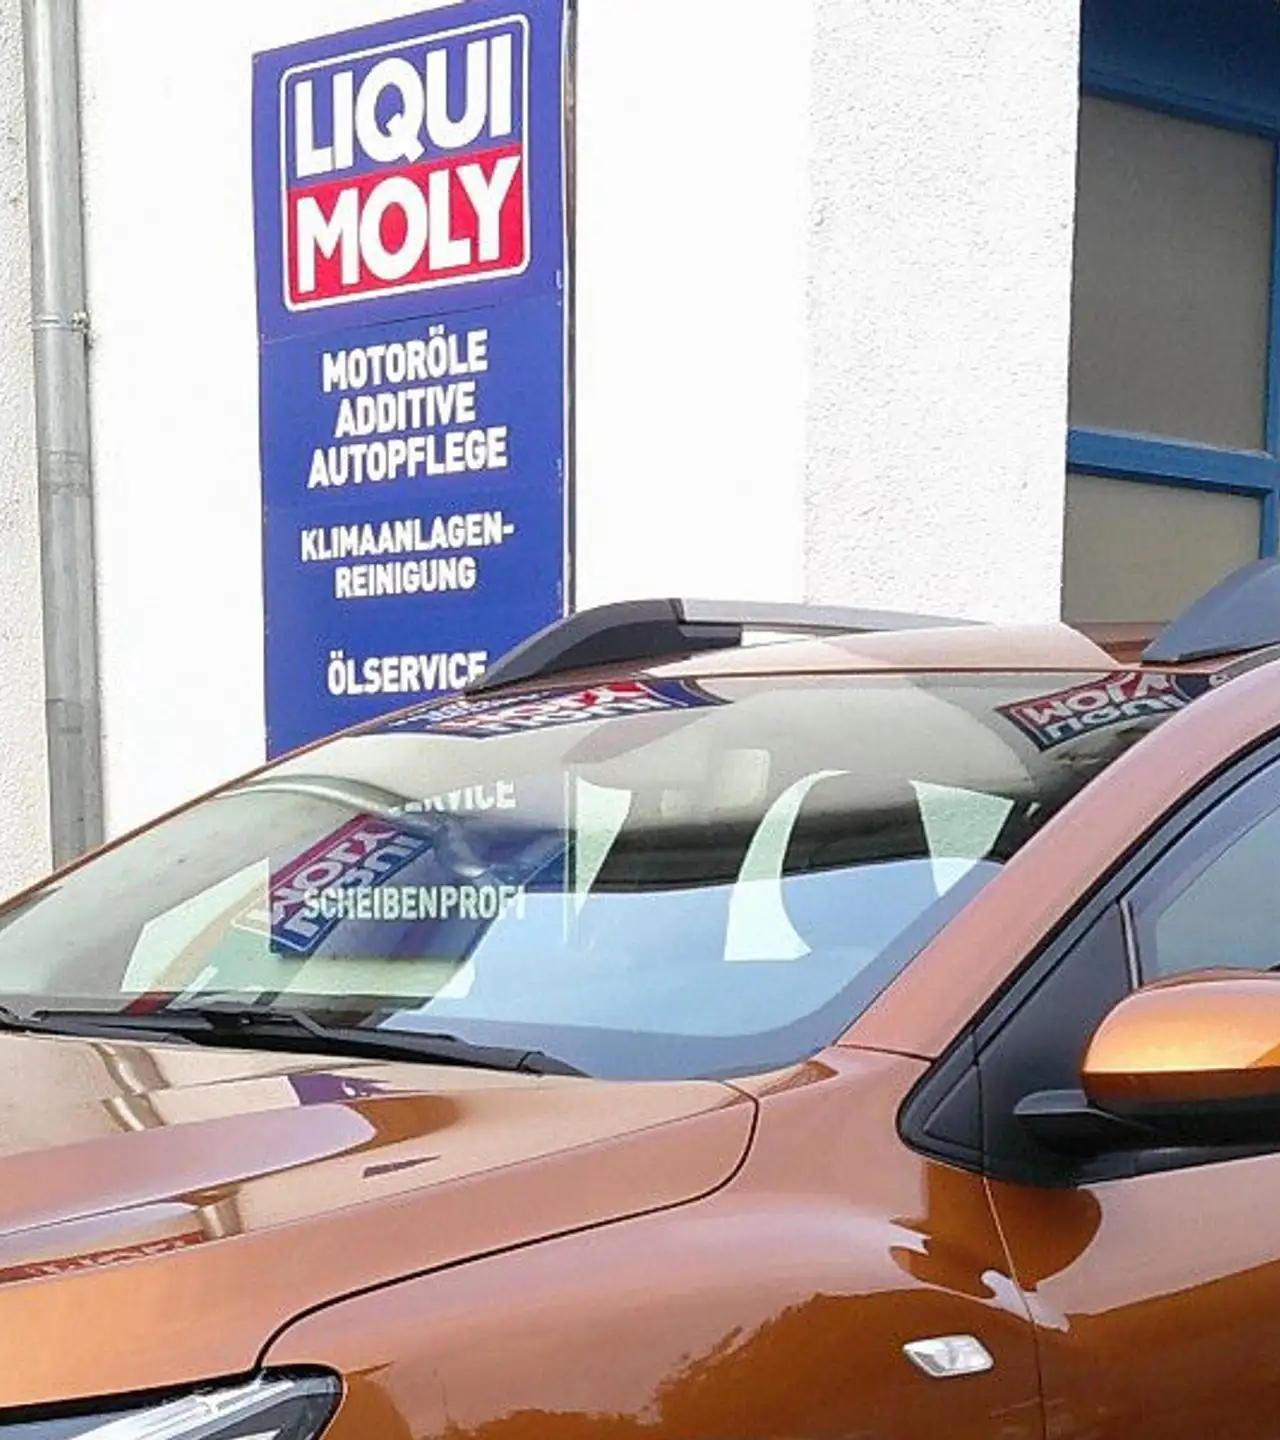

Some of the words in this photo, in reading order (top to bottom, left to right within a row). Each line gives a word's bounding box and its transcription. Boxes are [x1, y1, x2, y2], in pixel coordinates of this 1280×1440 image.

[294, 33, 513, 178] LIQUI
[296, 155, 521, 294] MOLY
[322, 324, 488, 393] MOTORÖLE
[334, 381, 475, 438] ADDITIVE
[307, 426, 507, 489] AUTOPFLEGE
[301, 511, 515, 563] KLIMAANLAGEN-
[334, 557, 476, 599] REINIGUNG
[328, 650, 488, 695] ÖLSERVICE
[388, 780, 516, 817] VICE
[303, 884, 526, 921] SCHEIBENPROFI
